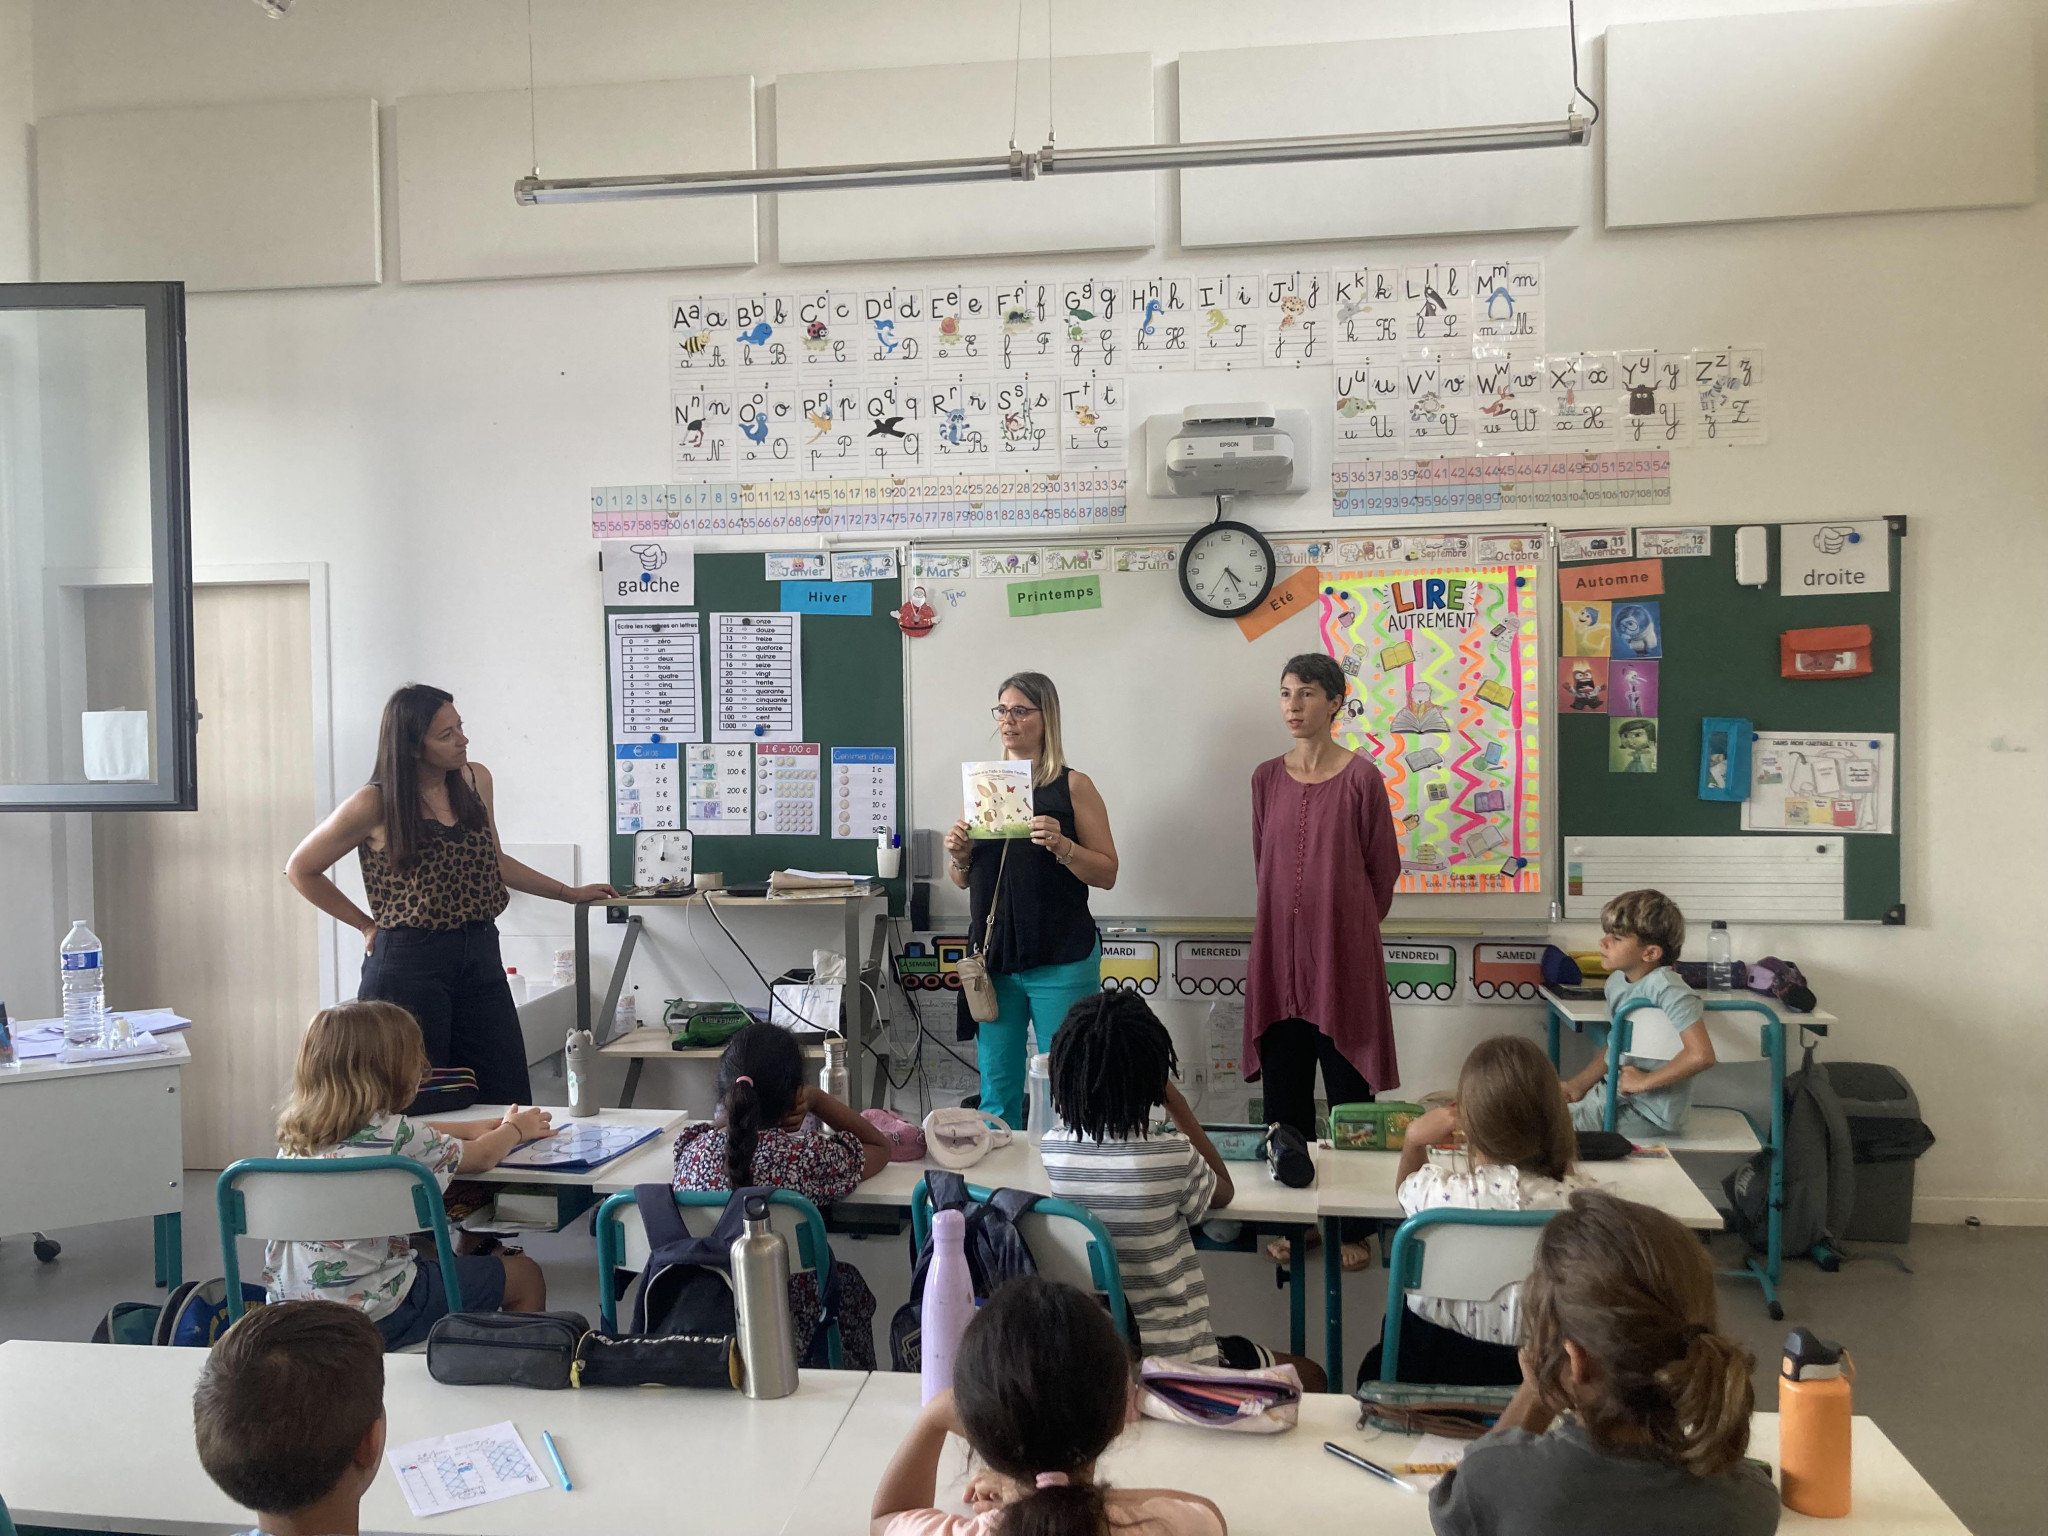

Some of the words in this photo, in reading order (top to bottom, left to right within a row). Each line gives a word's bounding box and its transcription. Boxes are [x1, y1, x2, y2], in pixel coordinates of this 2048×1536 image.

[1335, 472, 1349, 483] 35
[1351, 472, 1365, 482] 36
[1368, 472, 1381, 482] 37
[1385, 471, 1398, 481] 38
[1401, 470, 1415, 480] 39
[1417, 469, 1431, 479] 40
[1434, 469, 1447, 479] 41
[1451, 468, 1465, 478] 42
[1468, 468, 1482, 477] 43
[1485, 467, 1498, 477] 44
[596, 496, 603, 506] 0
[612, 497, 617, 505] 1
[626, 495, 633, 505] 2
[641, 495, 648, 504] 3
[656, 494, 662, 504] 4
[670, 493, 676, 504] 5
[685, 494, 692, 504] 6
[701, 493, 707, 503] 7
[716, 493, 722, 503] 8
[731, 493, 737, 503] 9
[743, 492, 754, 502] 10
[759, 492, 769, 502] 11
[773, 491, 785, 501] 12
[789, 490, 800, 500] 13
[804, 490, 816, 500] 14
[819, 490, 830, 499] 15
[834, 489, 846, 499] 16
[850, 488, 860, 498] 17
[865, 488, 876, 497] 18
[880, 487, 892, 497] 19
[894, 487, 907, 497] 20
[909, 486, 921, 496] 21
[924, 486, 937, 496] 22
[940, 486, 952, 496] 23
[955, 485, 968, 495] 24
[970, 485, 983, 494] 25
[986, 484, 999, 494] 26
[1001, 484, 1014, 494] 27
[1017, 483, 1030, 493] 28
[1032, 483, 1046, 493] 29
[1048, 482, 1060, 492] 30
[1063, 481, 1076, 492] 31
[1079, 481, 1092, 491] 32
[1095, 480, 1108, 491] 33
[1111, 480, 1124, 490] 34
[1356, 546, 1393, 561] Août
[1421, 549, 1467, 560] Septembre
[1495, 551, 1539, 561] Octobre
[1580, 545, 1627, 558] Novembre
[1061, 556, 1092, 570] Mai
[1286, 553, 1325, 564] Juillet
[994, 561, 1029, 574] Avril
[1138, 560, 1170, 570] Juin
[782, 567, 825, 577] Janvier
[851, 566, 889, 577] Février
[926, 566, 960, 577] Mars
[1804, 569, 1865, 586] droite
[618, 577, 680, 596] gauche
[1576, 572, 1649, 589] Automne
[808, 592, 847, 603] Hiver
[1018, 586, 1094, 604] Printemps
[1270, 591, 1294, 611] Eté
[1391, 579, 1467, 614] LIRE
[1388, 612, 1475, 632] AUTREMENT
[772, 745, 778, 753] €
[789, 745, 803, 753] 100
[1103, 947, 1136, 956] MARDI
[1192, 947, 1241, 957] MERCREDI
[1389, 951, 1439, 960] VENDREDI
[1497, 951, 1536, 960] SAMEDI
